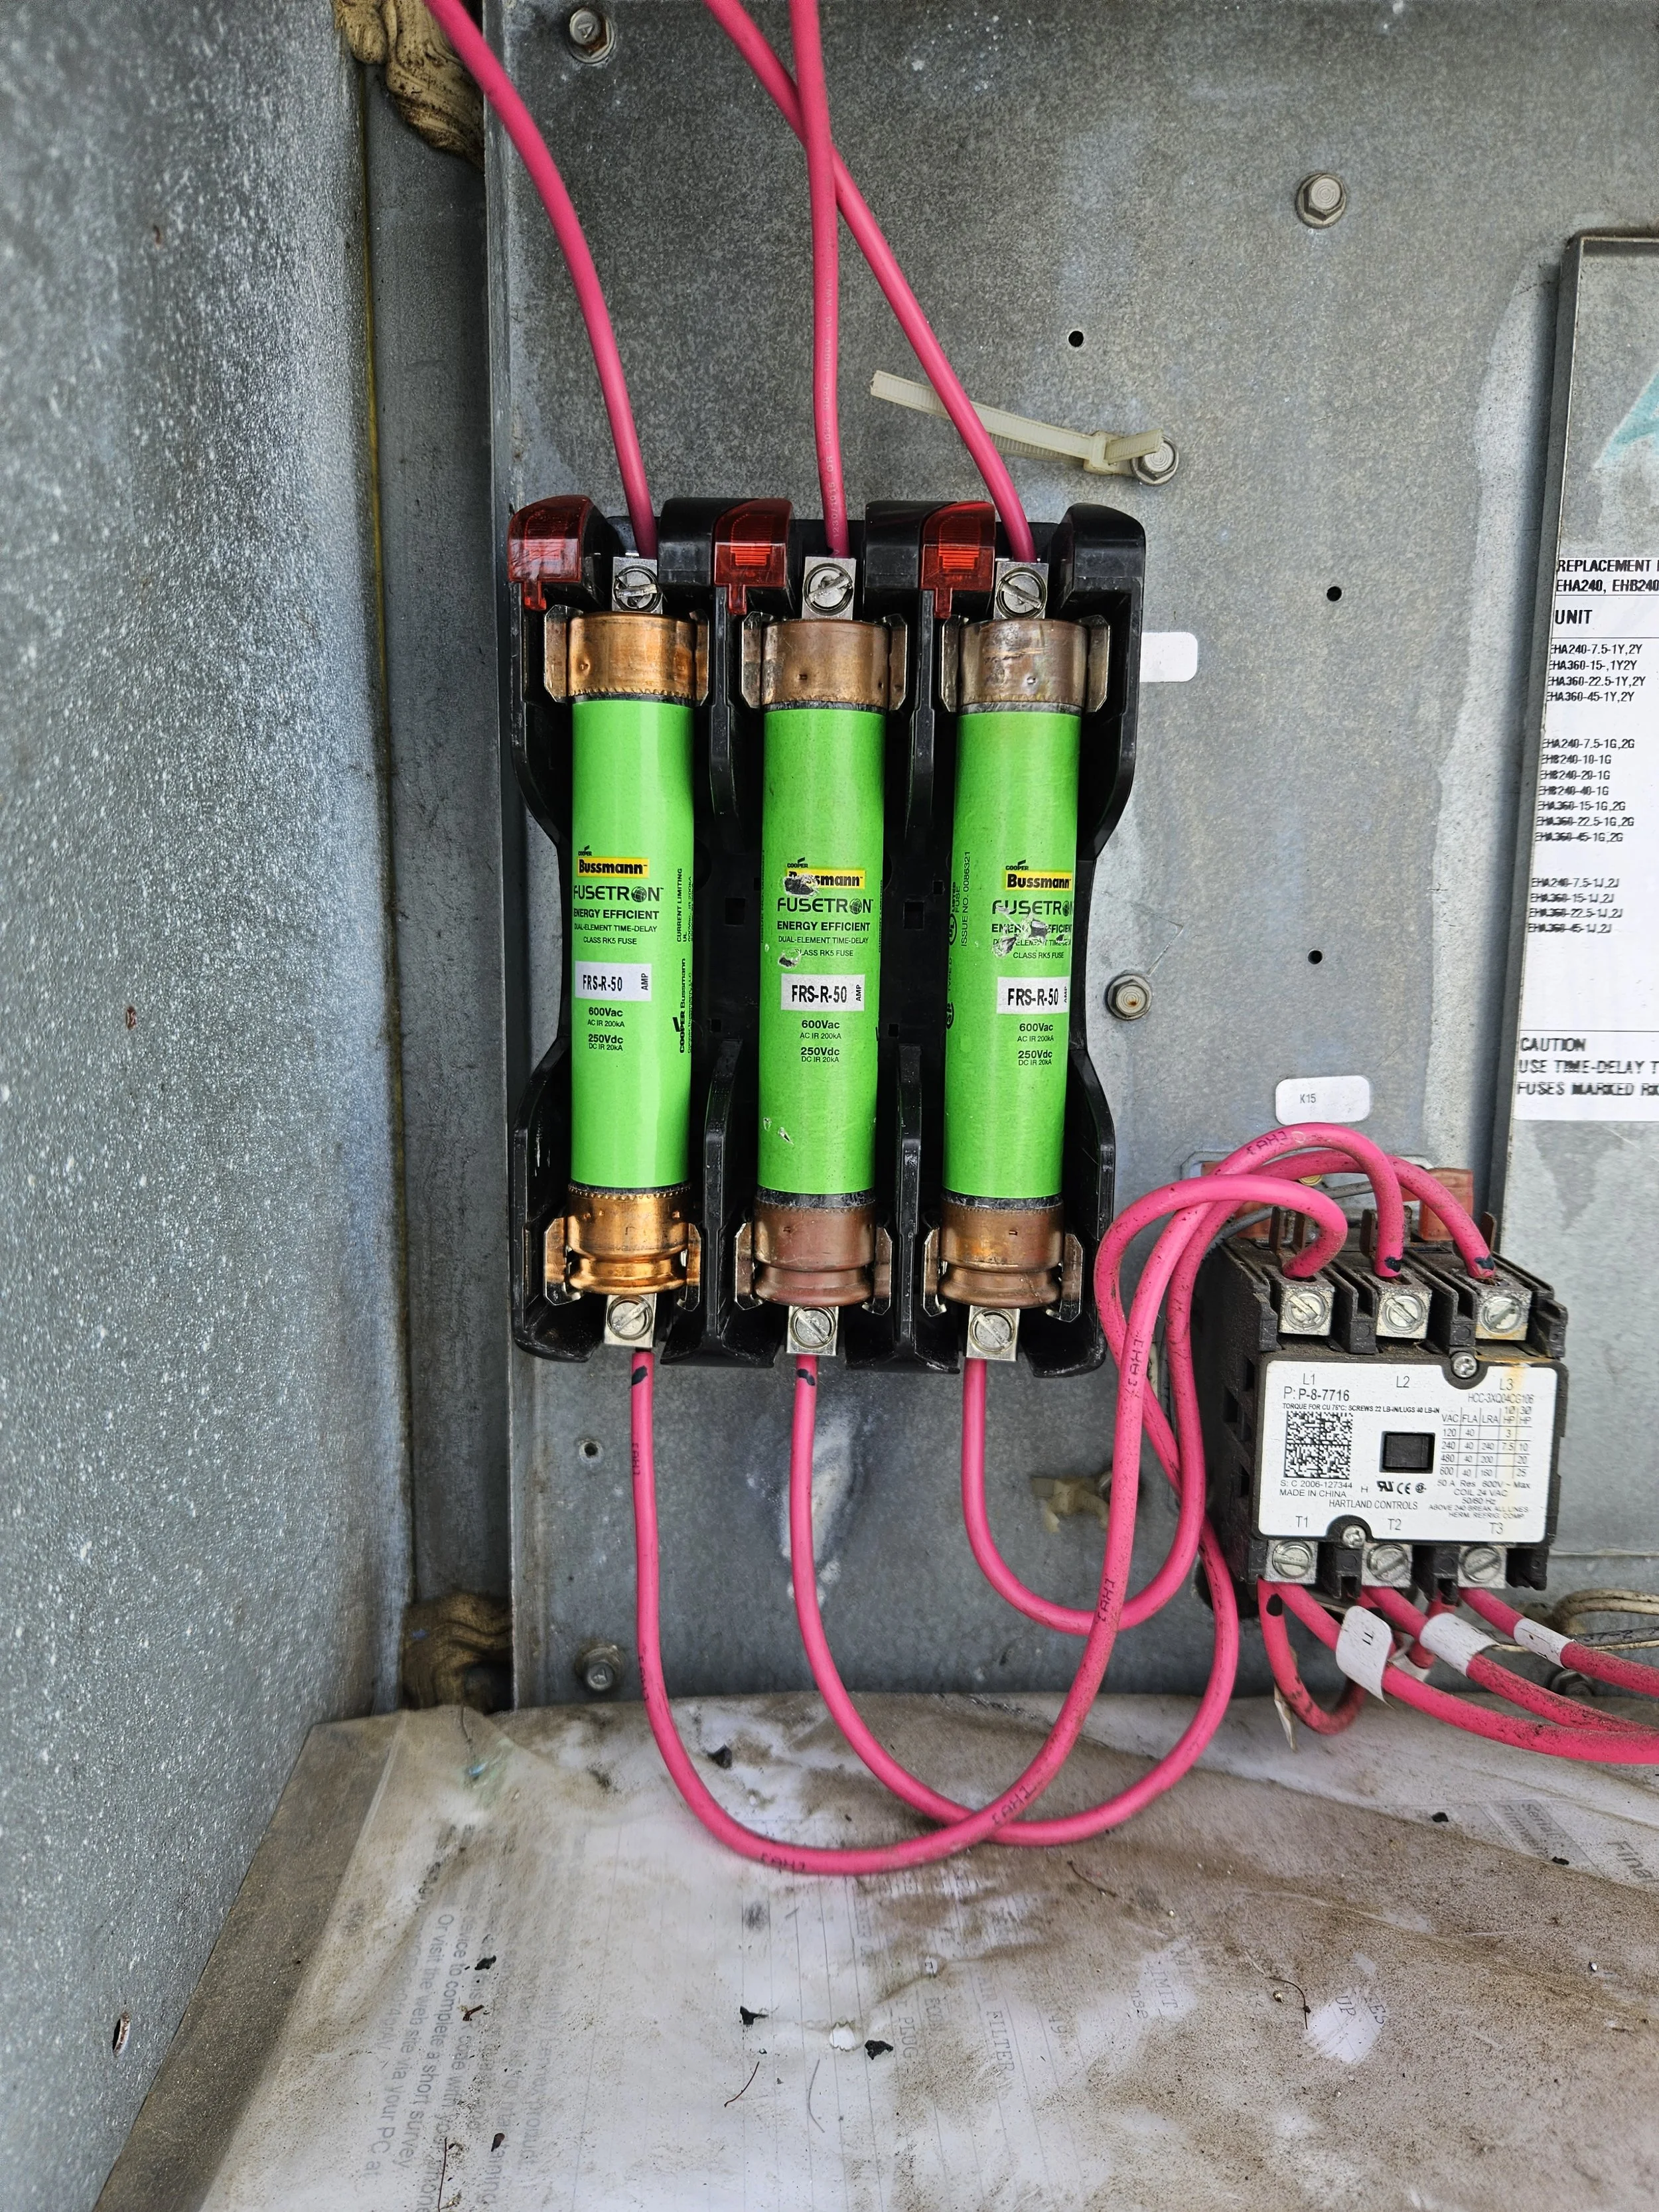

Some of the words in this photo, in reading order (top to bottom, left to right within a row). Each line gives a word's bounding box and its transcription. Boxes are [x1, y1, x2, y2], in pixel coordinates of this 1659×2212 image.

[1559, 559, 1652, 572] REPLACEMENT
[1556, 579, 1607, 594] EHA240,
[1555, 610, 1593, 625] UNIT
[579, 859, 644, 875] Bussmann
[1007, 873, 1070, 889] Bussmann
[777, 898, 871, 914] FUSETRON
[573, 908, 601, 919] ENERGY
[603, 909, 660, 920] EFFICIENT
[777, 921, 818, 931] ENERGY
[821, 922, 870, 931] EFFICIENT
[583, 974, 623, 992] FRS-R-50
[792, 985, 847, 1003] FRS-R-50
[1007, 988, 1058, 1006] FRS-R-50
[589, 1007, 623, 1017] 600Vac
[802, 1020, 840, 1029] 600Vac
[1019, 1023, 1053, 1032] 600Vac
[589, 1034, 624, 1044] 250Vdc
[1520, 1037, 1587, 1052] CAUTION
[801, 1047, 840, 1056] 250Vdc
[1018, 1050, 1052, 1059] 250Vdc
[1518, 1059, 1548, 1073] USE
[1554, 1060, 1645, 1074] TIME-DELAY
[1517, 1082, 1565, 1095] FUSES
[1299, 1094, 1317, 1104] K15
[1303, 1373, 1315, 1385] L1
[1396, 1375, 1410, 1388] L2
[1500, 1378, 1514, 1390] L3
[1283, 1386, 1295, 1399] P:
[1299, 1388, 1350, 1402] P-8-7716
[1441, 1414, 1459, 1423] VAC
[1462, 1414, 1479, 1423] FLA
[1482, 1415, 1499, 1424] LRA
[1443, 1428, 1456, 1437] 120
[1465, 1428, 1475, 1437] 40
[1506, 1430, 1512, 1438] 3
[1465, 1441, 1474, 1450] 40
[1439, 1467, 1454, 1475] 600
[1329, 1499, 1372, 1509] HARTLAND
[1374, 1501, 1418, 1510] CONTROLS
[1295, 1516, 1309, 1528] T1
[1388, 1518, 1402, 1530] T2
[1489, 1522, 1504, 1534] T3
[435, 1914, 454, 1931] Or
[427, 1935, 447, 1962] visit
[419, 1968, 440, 1989] the
[430, 1981, 458, 2047] complete
[400, 2029, 421, 2053] site
[899, 2017, 918, 2058] PLUG
[987, 2011, 1015, 2071] FILTER
[393, 2059, 412, 2079] via
[409, 2065, 439, 2104] short
[381, 2086, 403, 2121] your
[371, 2127, 395, 2153] PC
[393, 2111, 423, 2168] survey
